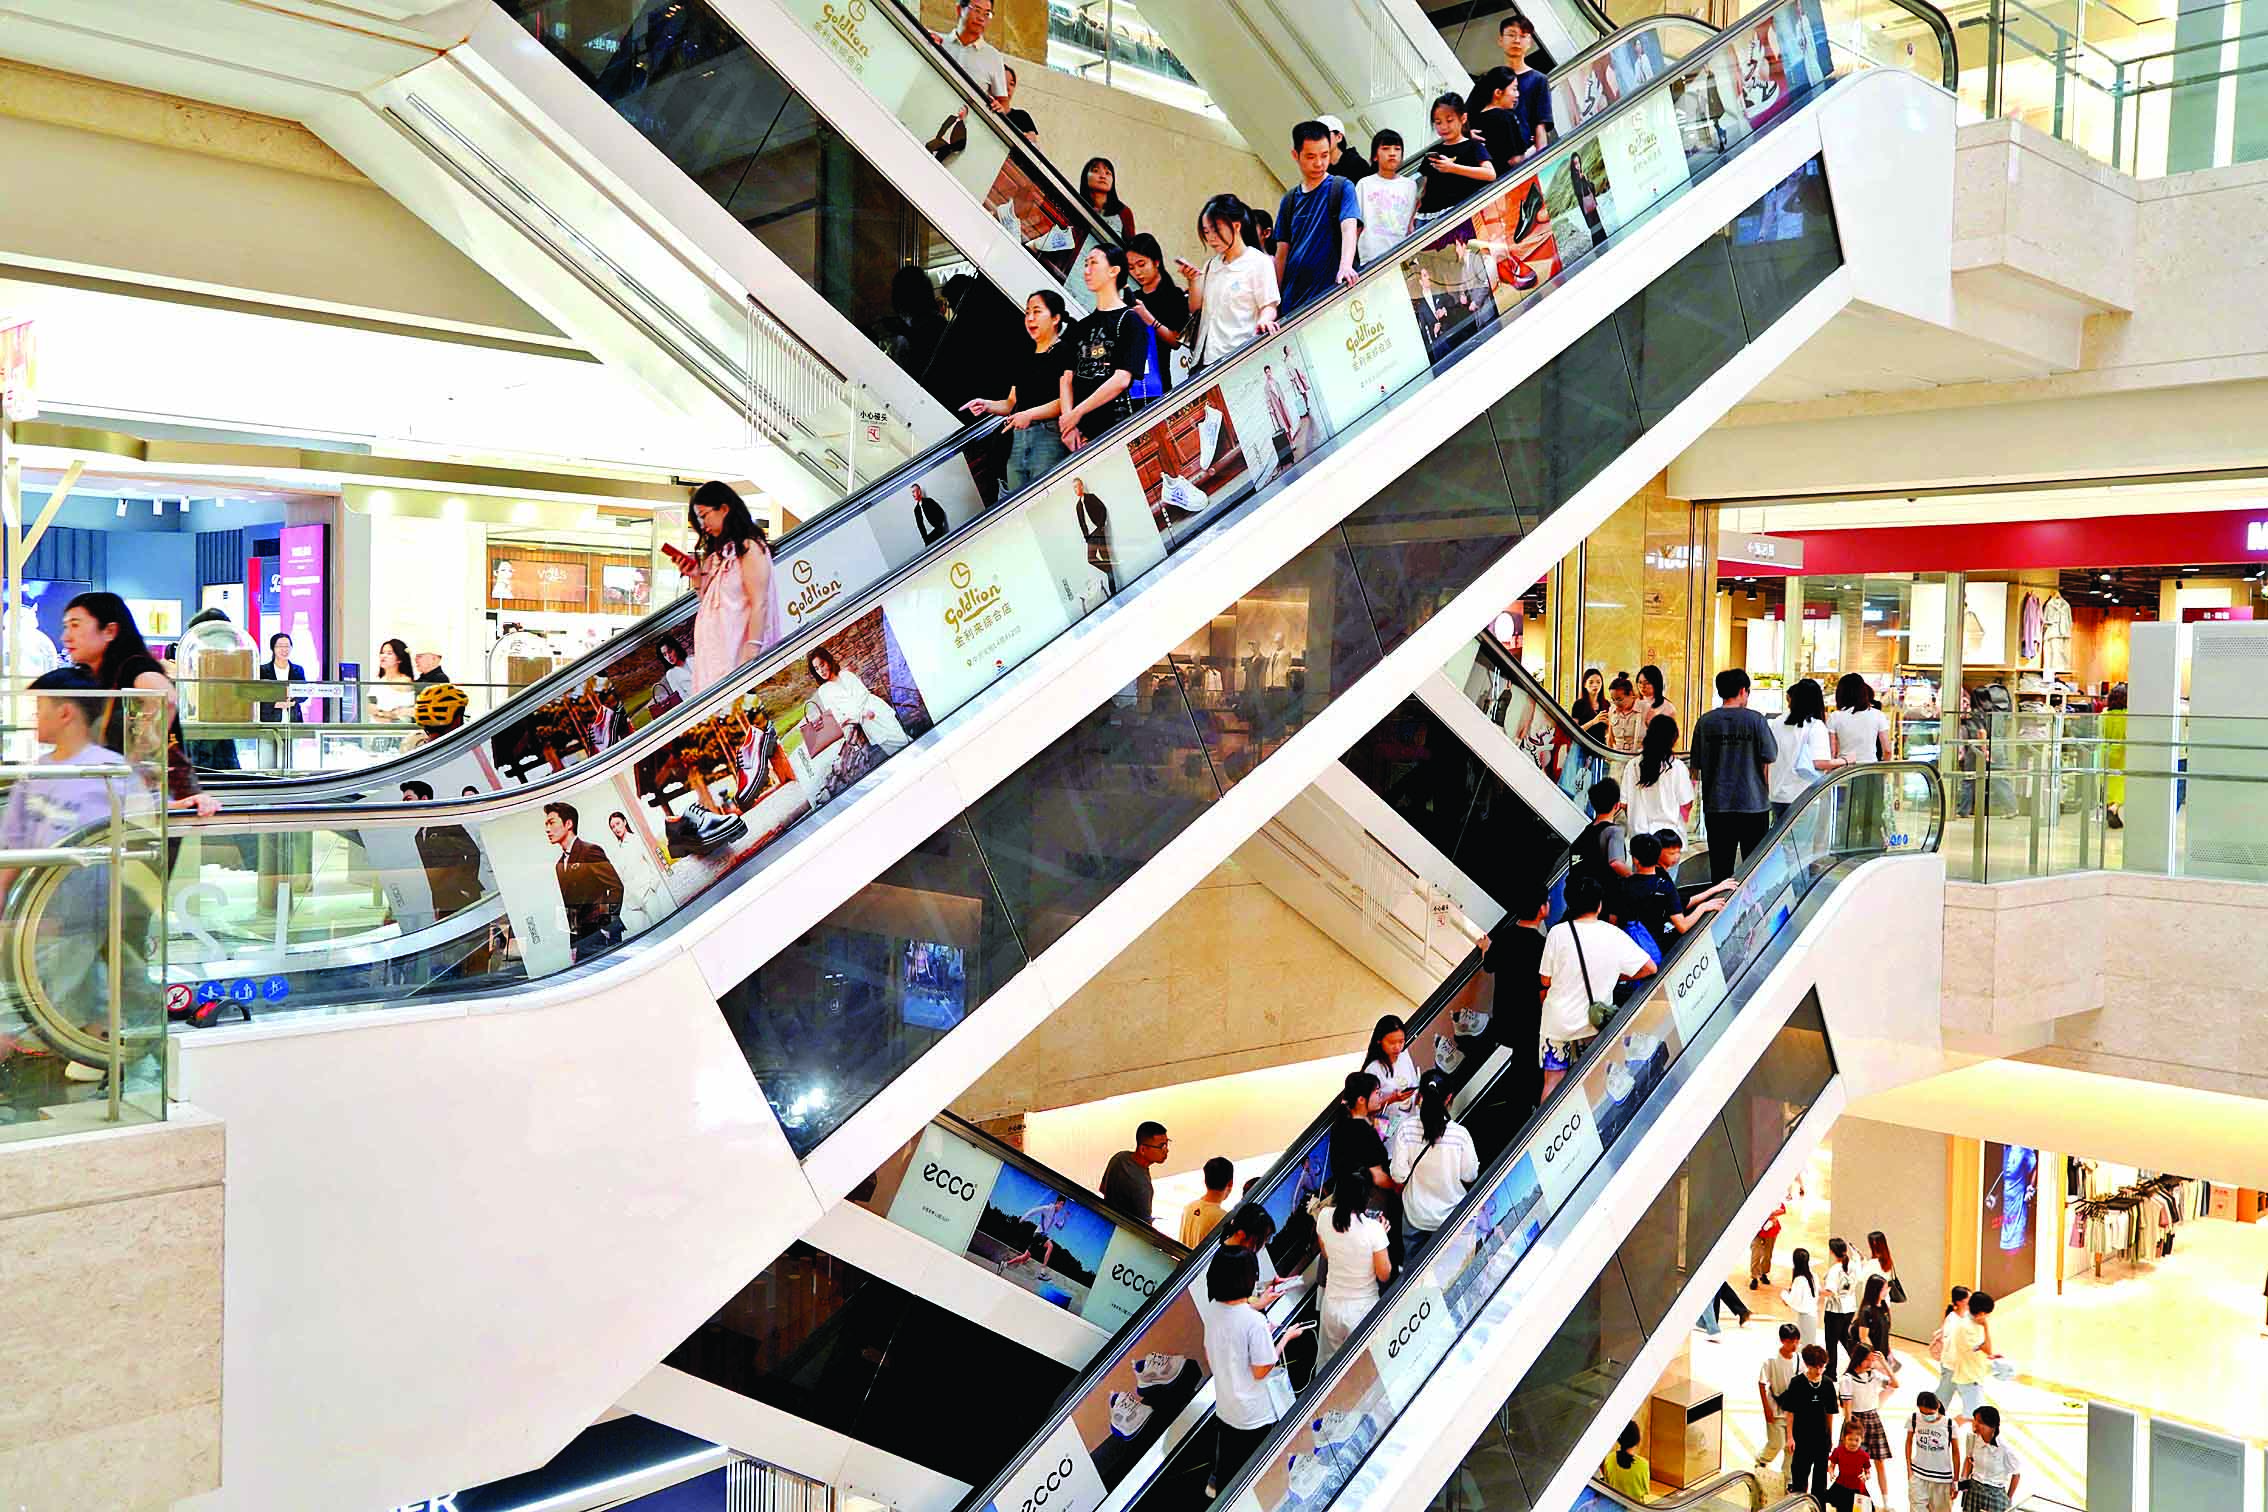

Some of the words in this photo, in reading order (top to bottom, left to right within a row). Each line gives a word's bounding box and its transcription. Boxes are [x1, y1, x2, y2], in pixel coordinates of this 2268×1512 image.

[787, 580, 842, 623] Goldlion
[944, 584, 1002, 633] Goldlion
[1677, 955, 1709, 998] ecco
[1544, 1114, 1581, 1163] ecco
[923, 1162, 975, 1201] ecco
[1111, 1263, 1155, 1297] ecco
[1388, 1301, 1431, 1358] ecco
